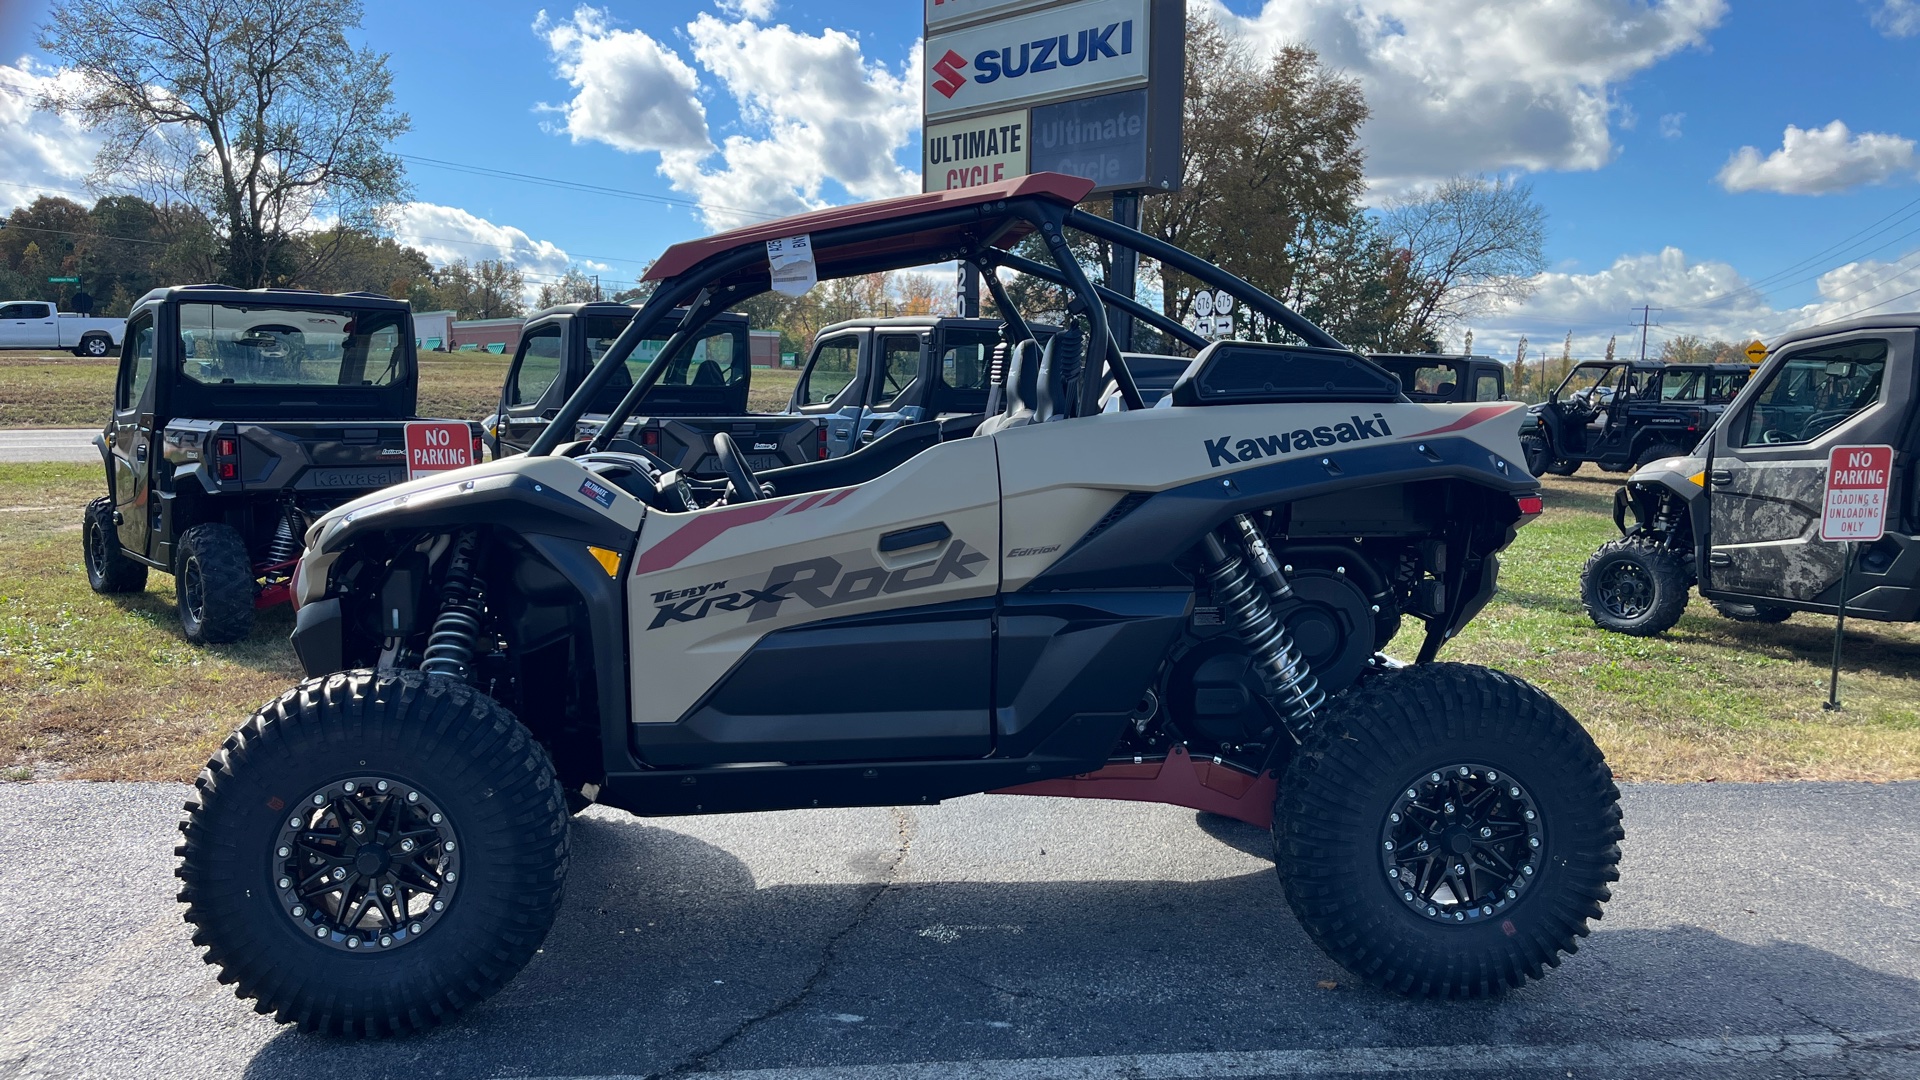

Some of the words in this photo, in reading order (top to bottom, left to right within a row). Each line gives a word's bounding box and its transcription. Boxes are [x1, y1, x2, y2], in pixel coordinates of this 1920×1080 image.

[974, 20, 1133, 84] SUZUKI
[1042, 111, 1141, 148] Ultimate
[930, 124, 1021, 164] ULTIMATE
[1197, 297, 1210, 310] 676
[1217, 295, 1231, 308] 675
[425, 429, 450, 446] NO
[1203, 412, 1393, 468] Kawasaki
[413, 448, 466, 465] PARKING
[1848, 452, 1872, 468] NO
[1833, 469, 1884, 485] PARKING
[1832, 494, 1869, 505] LOADING
[1872, 494, 1879, 504] &
[1829, 507, 1879, 519] UNLOADING
[1841, 521, 1865, 532] ONLY
